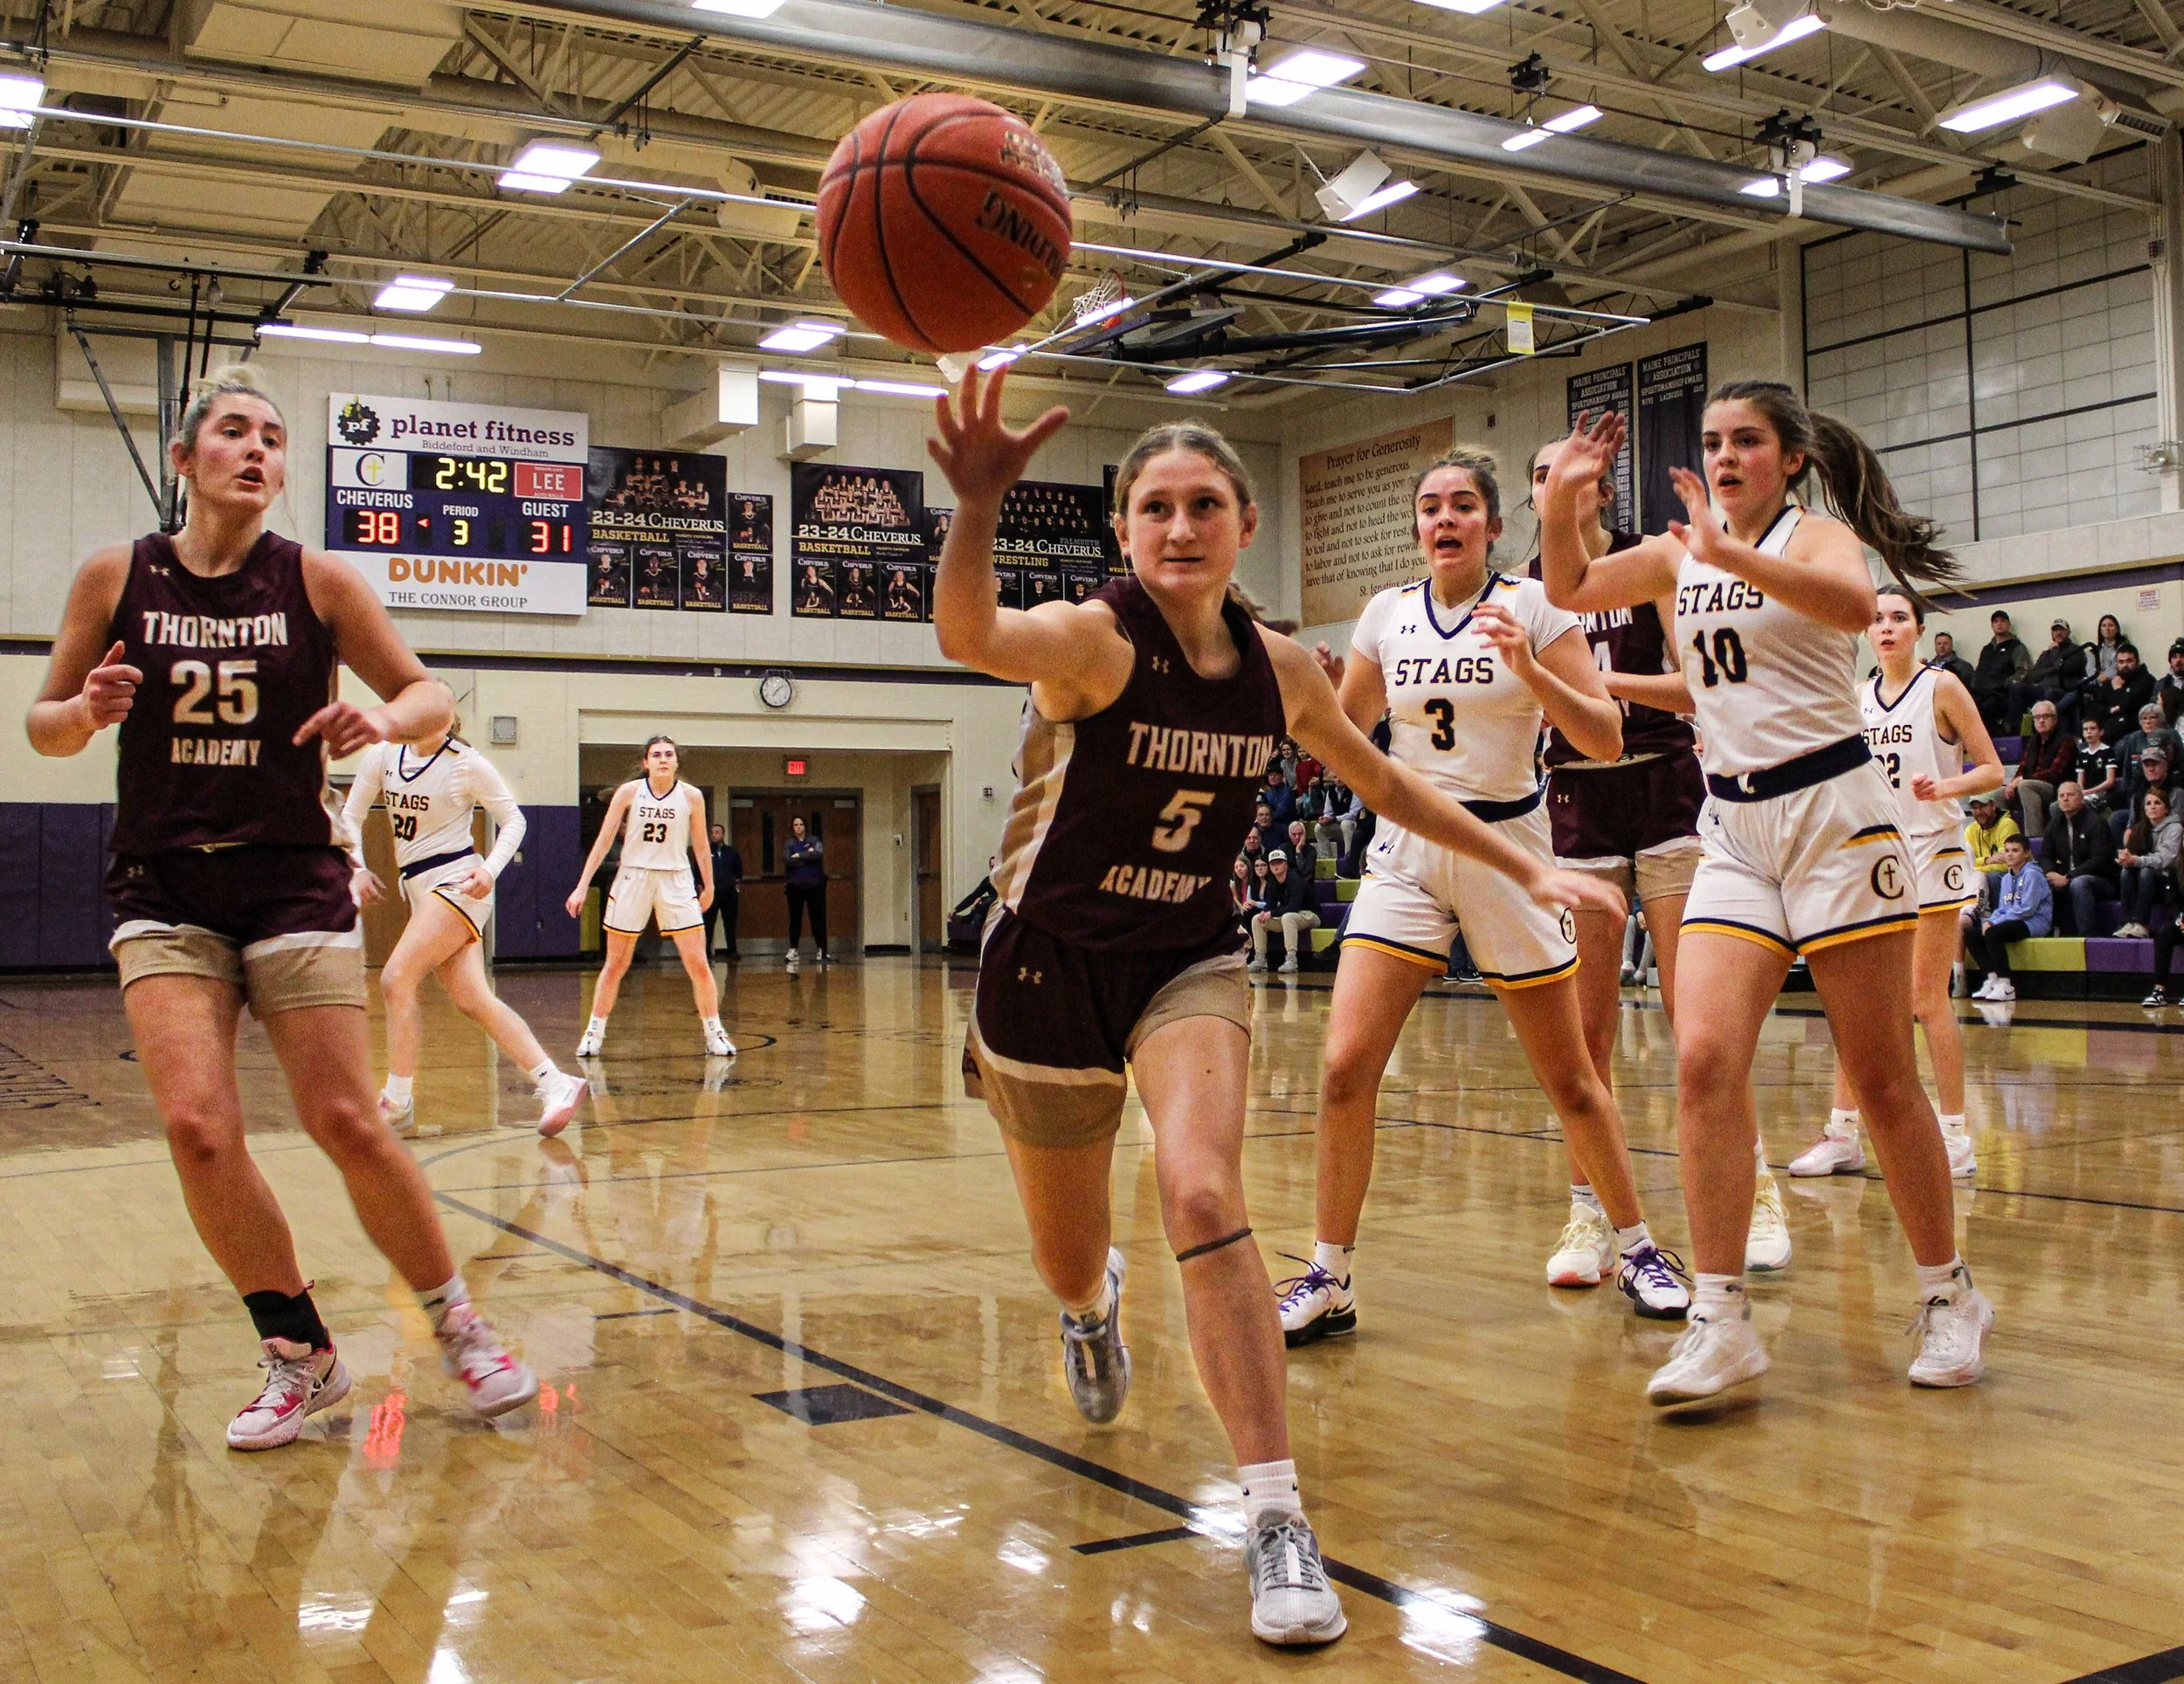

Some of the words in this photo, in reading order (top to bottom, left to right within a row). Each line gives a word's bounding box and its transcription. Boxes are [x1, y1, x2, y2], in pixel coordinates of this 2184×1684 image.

[346, 418, 371, 432] pf
[390, 414, 477, 439] planet
[486, 420, 575, 446] fitness
[422, 439, 473, 453] Biddeford
[476, 443, 496, 455] and
[498, 445, 549, 458] Windham
[1327, 453, 1354, 470] Prayer
[1357, 447, 1370, 461] for
[1372, 434, 1420, 457] Generosity
[435, 457, 508, 493] 2:42
[533, 473, 565, 491] LEE
[1324, 476, 1343, 489] teach
[1344, 475, 1355, 485] me
[1357, 472, 1364, 482] to
[1365, 468, 1374, 480] be
[336, 489, 413, 509] CHEVERUS
[522, 501, 570, 518] GUEST
[1305, 495, 1325, 510] Teach
[1326, 495, 1337, 504] me
[1339, 492, 1346, 502] to
[1347, 489, 1365, 500] serve
[1367, 485, 1380, 498] you
[1382, 481, 1391, 491] as
[443, 505, 479, 517] PERIOD
[592, 510, 646, 528] 23-24
[648, 512, 724, 532] CHEVERUS
[1305, 514, 1312, 526] to
[1313, 511, 1327, 527] give
[1329, 507, 1343, 520] and
[1344, 503, 1355, 514] not
[1357, 502, 1365, 513] to
[1365, 498, 1386, 511] count
[1388, 493, 1400, 506] the
[356, 510, 400, 545] 38
[453, 520, 468, 546] 3
[530, 521, 572, 553] 31
[592, 528, 670, 543] BASKETBALL
[798, 524, 849, 539] 23-24
[851, 526, 921, 544] CHEVERUS
[1305, 529, 1313, 541] to
[1314, 527, 1330, 541] fight
[1330, 523, 1344, 535] and
[1346, 521, 1358, 532] not
[1359, 518, 1366, 528] to
[1368, 515, 1386, 527] heed
[1387, 511, 1400, 522] the
[798, 542, 871, 556] BASKETBALL
[1037, 539, 1102, 556] CHEVERUS
[1060, 537, 1100, 547] FALMOUTH
[1305, 546, 1313, 556] to
[1314, 542, 1325, 555] toil
[1327, 540, 1340, 551] and
[1341, 537, 1353, 549] not
[1355, 535, 1363, 545] to
[1364, 530, 1379, 543] seek
[1380, 528, 1392, 541] for
[388, 557, 529, 587] DUNKIN'
[1305, 562, 1313, 572] to
[1314, 557, 1334, 570] labor
[1333, 554, 1347, 566] and
[1348, 551, 1360, 563] not
[1362, 549, 1370, 560] to
[1370, 547, 1383, 558] ask
[1384, 544, 1395, 557] for
[1305, 576, 1320, 588] save
[1322, 572, 1336, 584] that
[1337, 569, 1345, 582] of
[1346, 564, 1378, 580] knowing
[1379, 561, 1393, 573] that
[1395, 559, 1399, 570] I
[1400, 556, 1410, 569] do
[389, 591, 417, 604] THE
[420, 593, 476, 607] CONNOR
[480, 597, 529, 609] GROUP
[1359, 585, 1368, 597] St.
[1677, 581, 1765, 616] STAGS
[142, 611, 288, 649] THORNTON
[1693, 627, 1747, 688] 10
[1395, 657, 1494, 687] STAGS
[170, 659, 259, 726] 25
[1424, 698, 1456, 751] 3
[1862, 724, 1912, 746] STAGS
[170, 736, 261, 767] ACADEMY
[1127, 721, 1274, 778] THORNTON
[384, 790, 430, 811] STAGS
[639, 806, 675, 819] STAGS
[392, 813, 418, 842] 20
[643, 823, 667, 844] 23
[1151, 789, 1216, 853] 5
